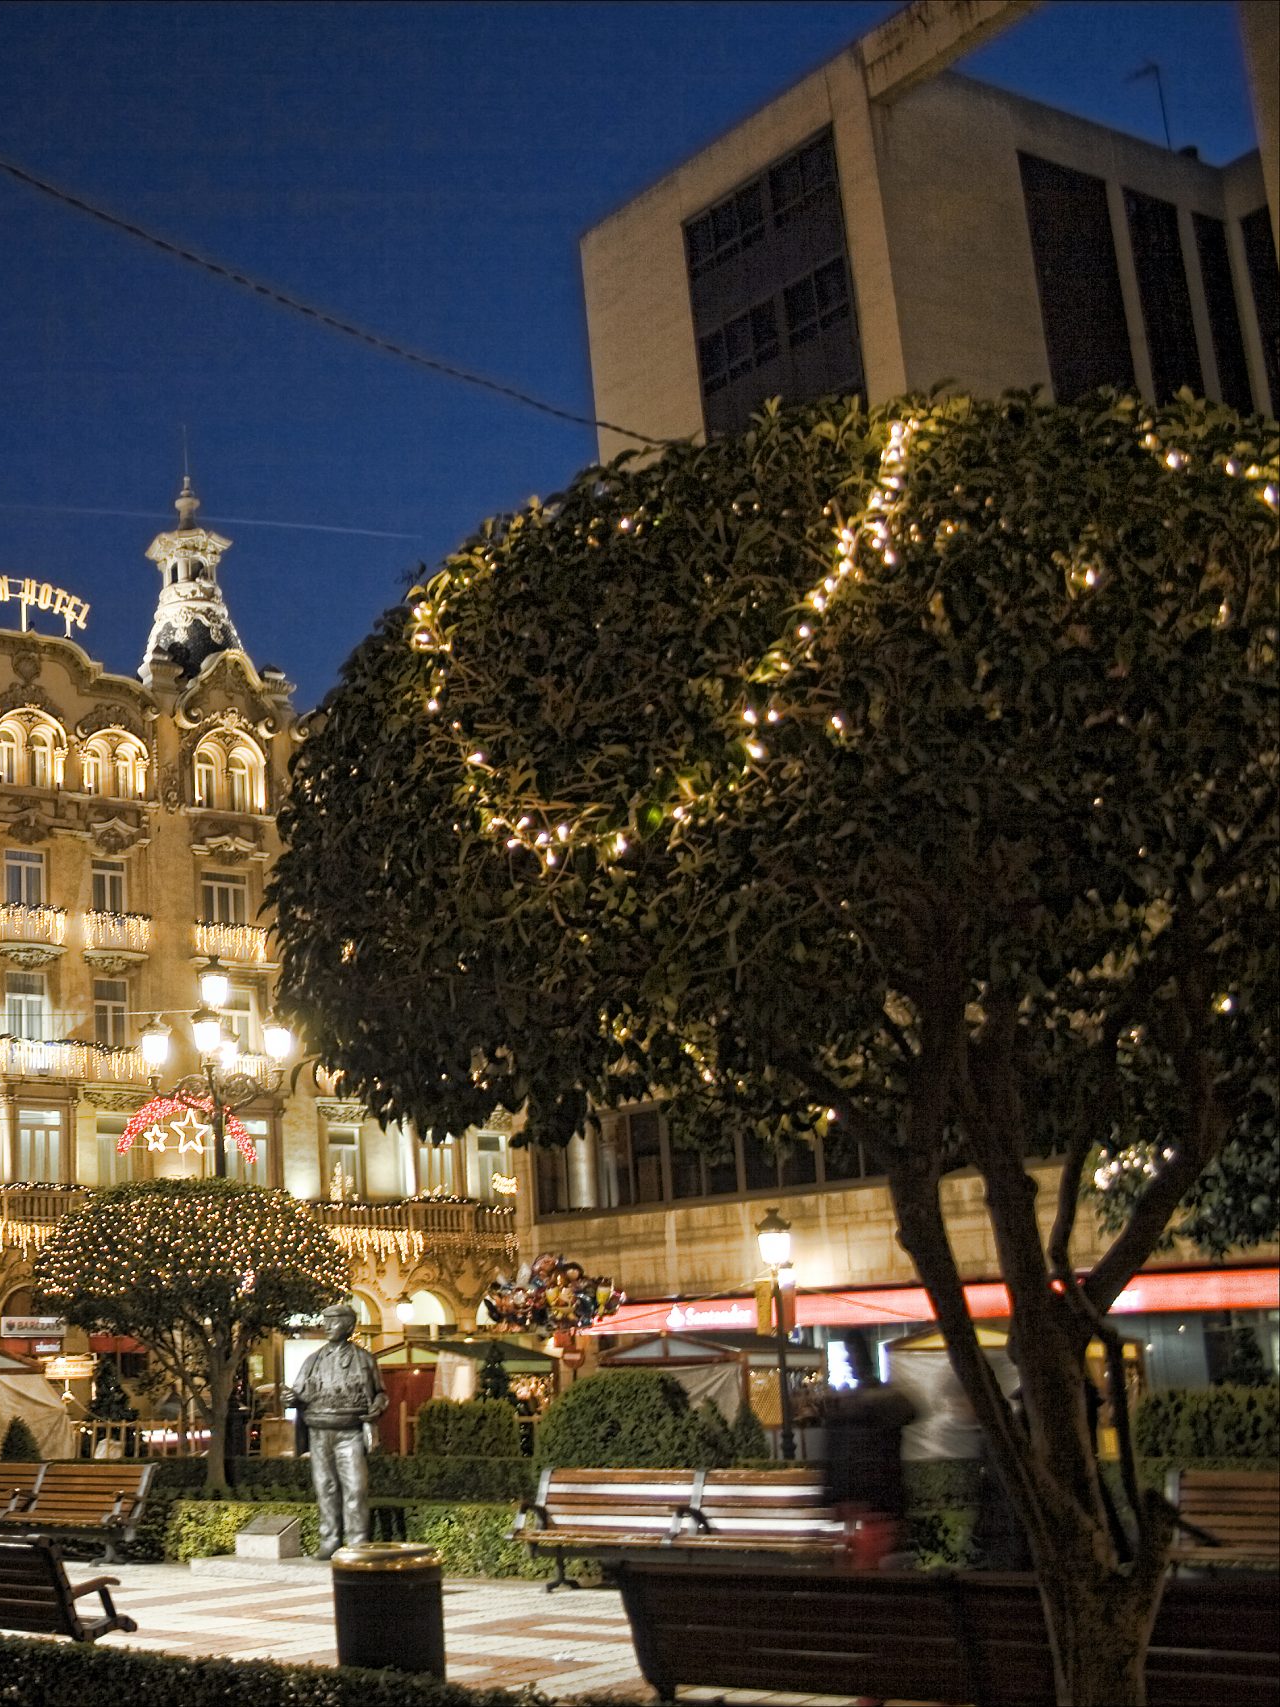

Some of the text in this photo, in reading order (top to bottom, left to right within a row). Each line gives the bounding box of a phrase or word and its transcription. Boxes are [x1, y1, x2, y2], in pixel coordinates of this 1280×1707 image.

[22, 578, 90, 629] HOTEL
[17, 1320, 62, 1331] BARCLAYS
[685, 1304, 752, 1326] Santander
